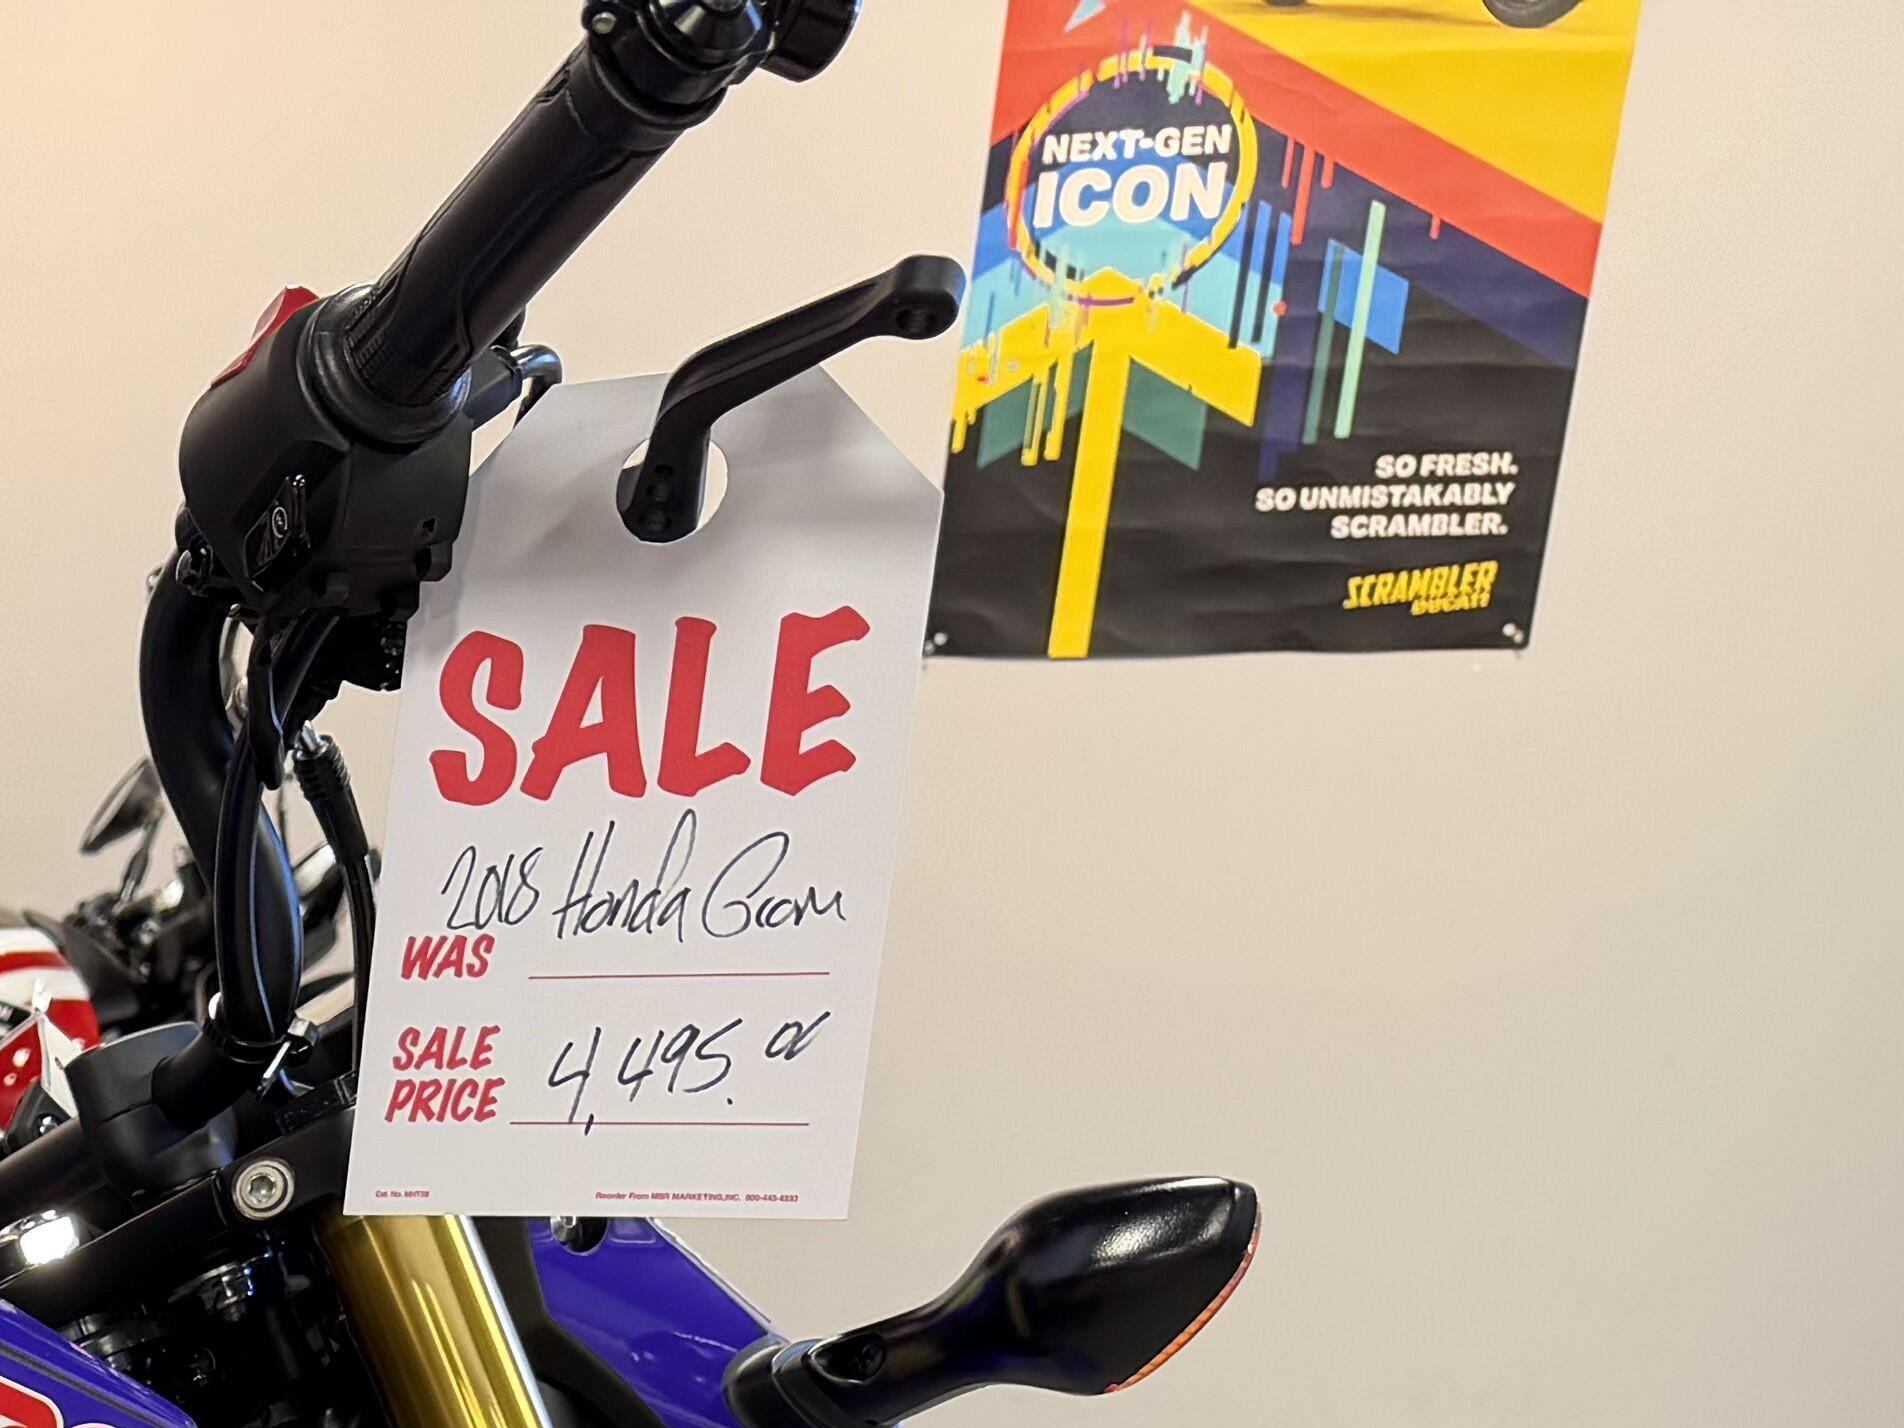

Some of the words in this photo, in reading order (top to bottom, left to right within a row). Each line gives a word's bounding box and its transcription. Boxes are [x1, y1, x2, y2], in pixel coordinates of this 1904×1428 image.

[1042, 124, 1232, 164] NEXT-GEN
[1033, 161, 1228, 229] ICON
[1375, 454, 1417, 479] SO
[1420, 452, 1519, 477] FRESH.
[1255, 487, 1296, 512] SO
[1299, 482, 1516, 511] UNMISTAKABLY
[1330, 512, 1509, 539] SCRAMBLER.
[1343, 560, 1498, 609] SCRAMBLER
[429, 605, 871, 806] SALE
[441, 845, 543, 931] 2018
[552, 808, 693, 943] Honda
[700, 831, 848, 938] Grom
[400, 933, 496, 981] WAS
[393, 1025, 501, 1071] SALE
[385, 1076, 505, 1124] PRICE
